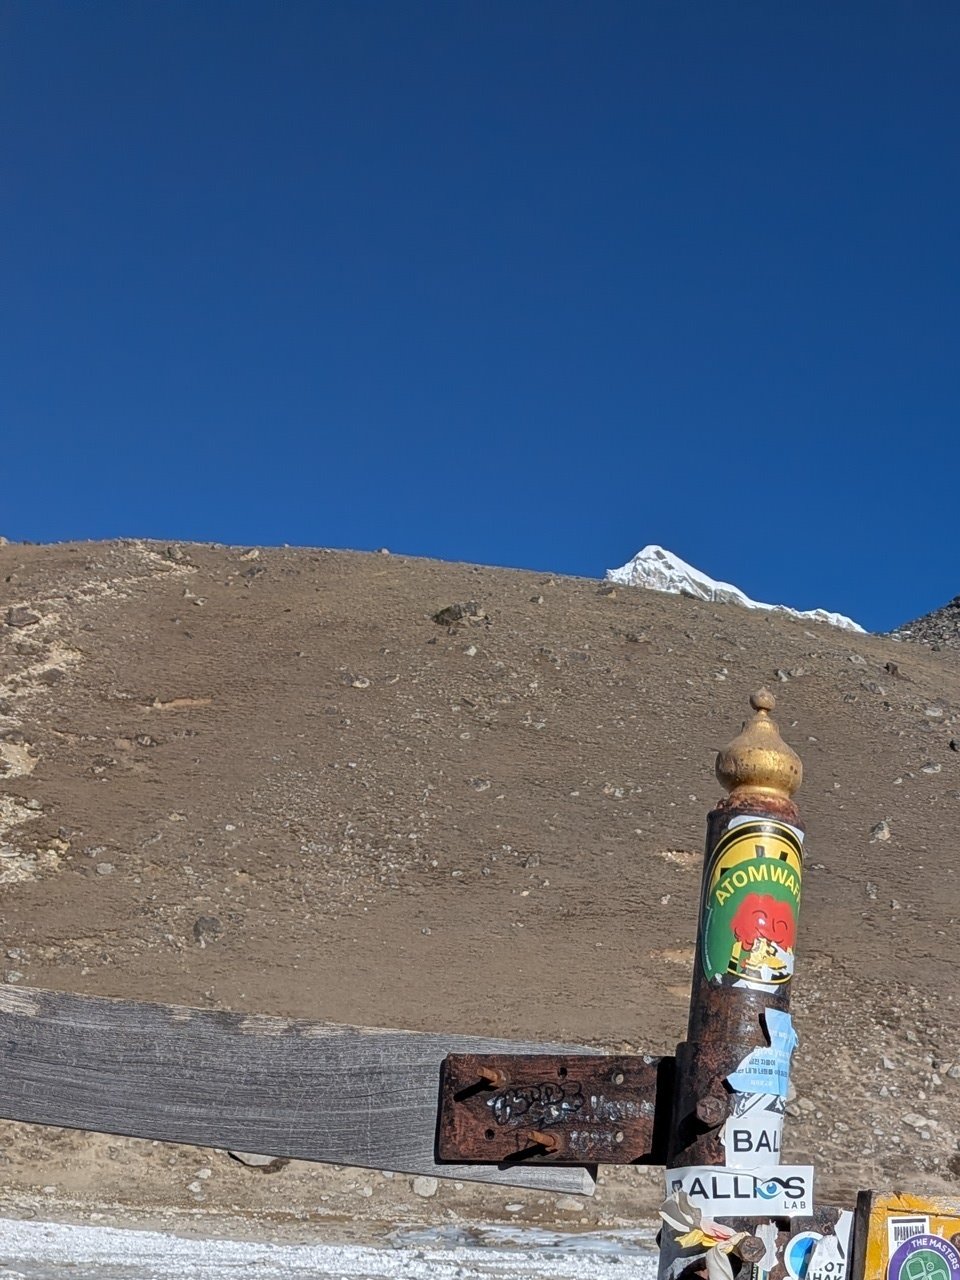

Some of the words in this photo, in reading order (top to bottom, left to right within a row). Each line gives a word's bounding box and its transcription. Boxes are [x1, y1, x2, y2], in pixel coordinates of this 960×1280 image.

[783, 1200, 807, 1209] LAB
[911, 1237, 928, 1249] THE
[929, 1238, 960, 1270] MASTERS
